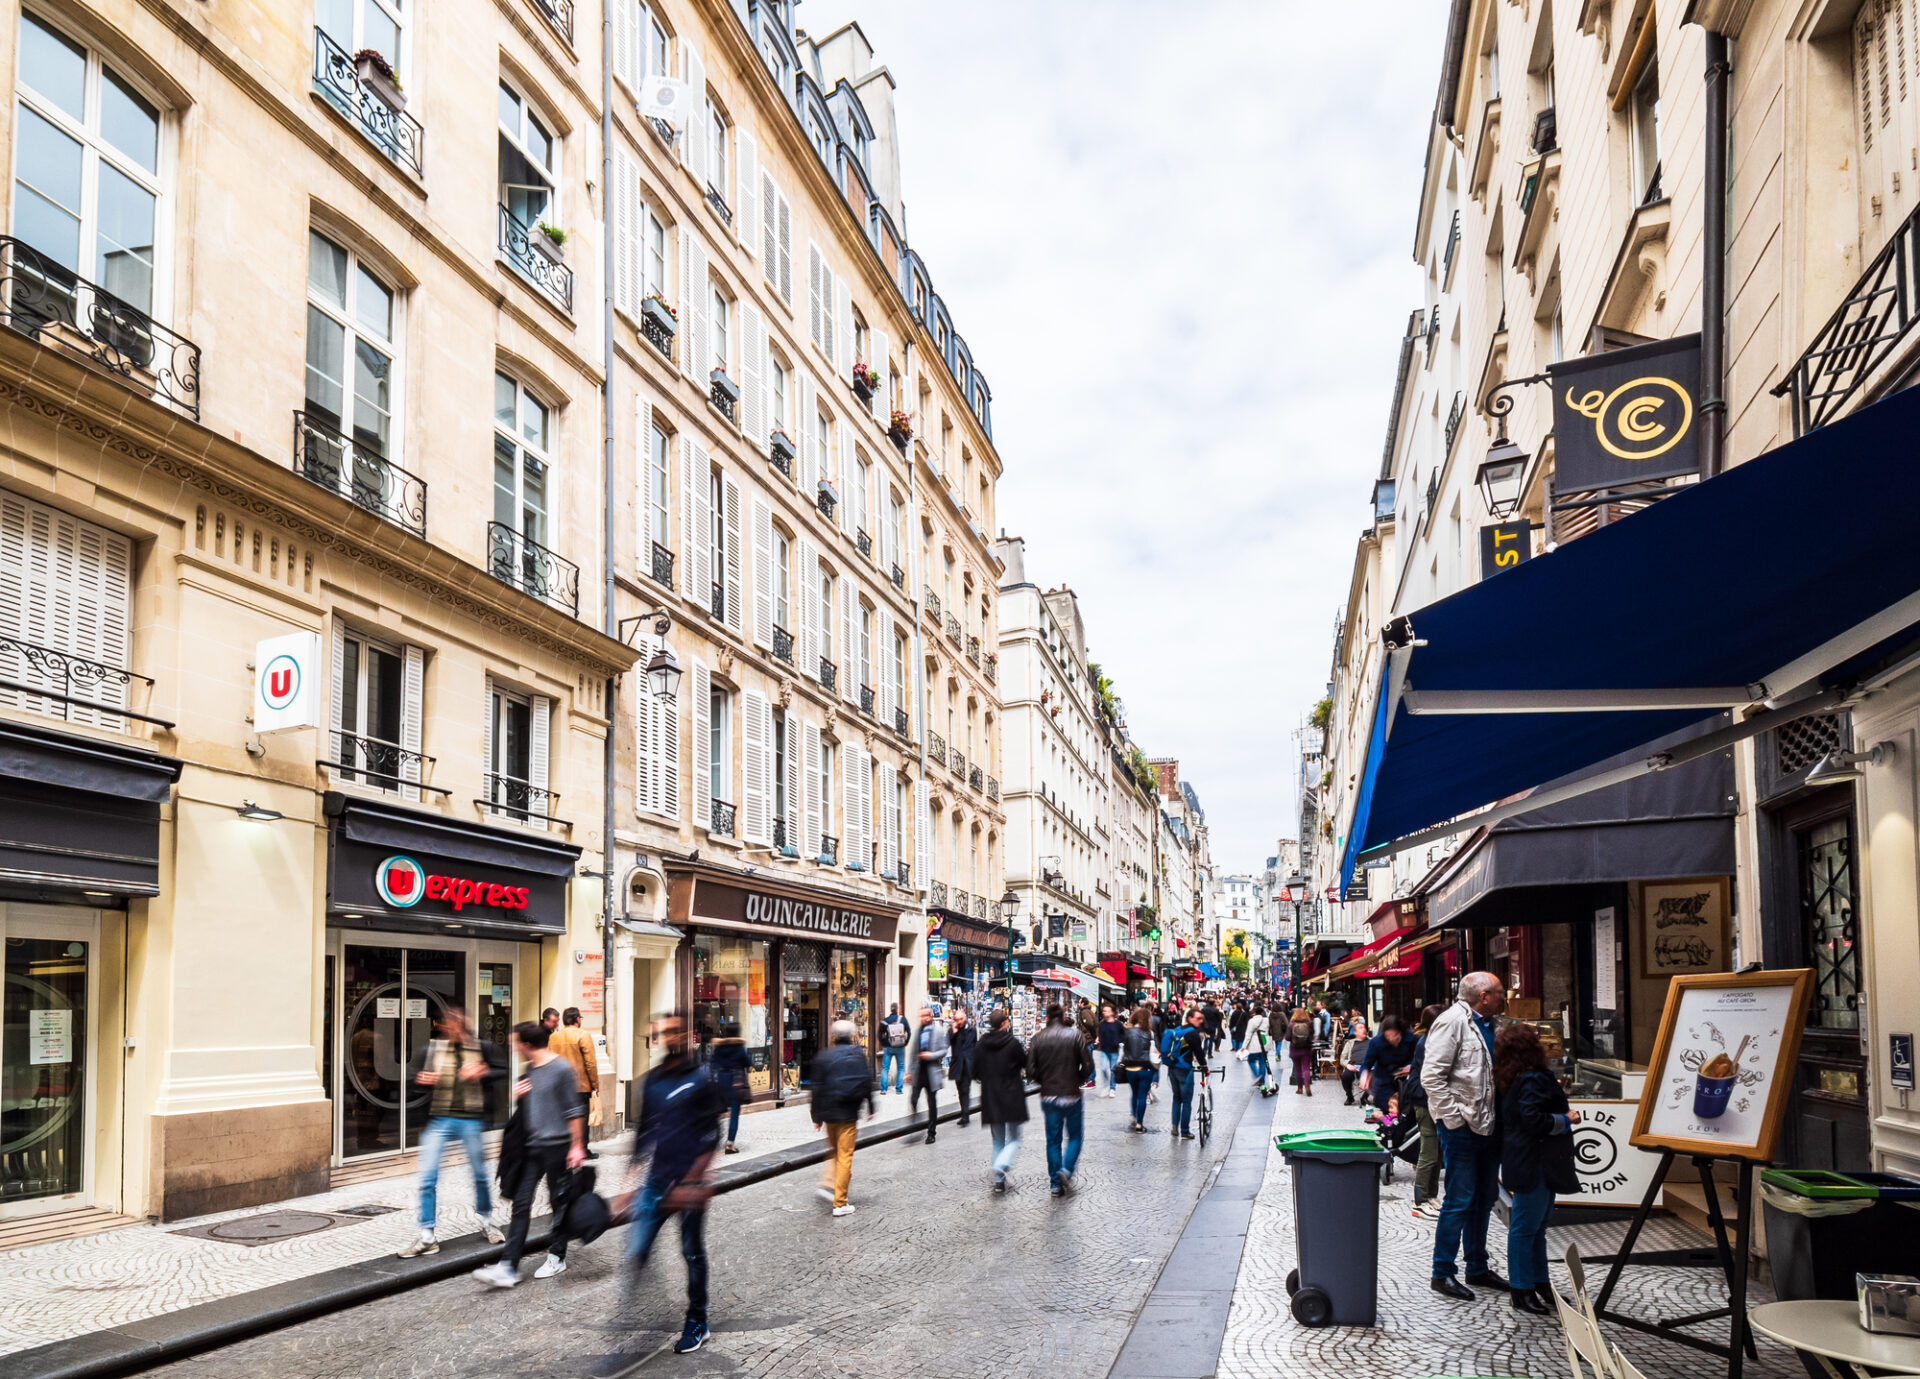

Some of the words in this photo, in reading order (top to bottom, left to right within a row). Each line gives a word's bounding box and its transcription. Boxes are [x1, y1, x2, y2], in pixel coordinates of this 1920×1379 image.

[270, 668, 291, 698] U
[425, 875, 529, 911] express
[746, 894, 872, 937] QUINCAILLERIE
[1595, 1111, 1616, 1127] DE
